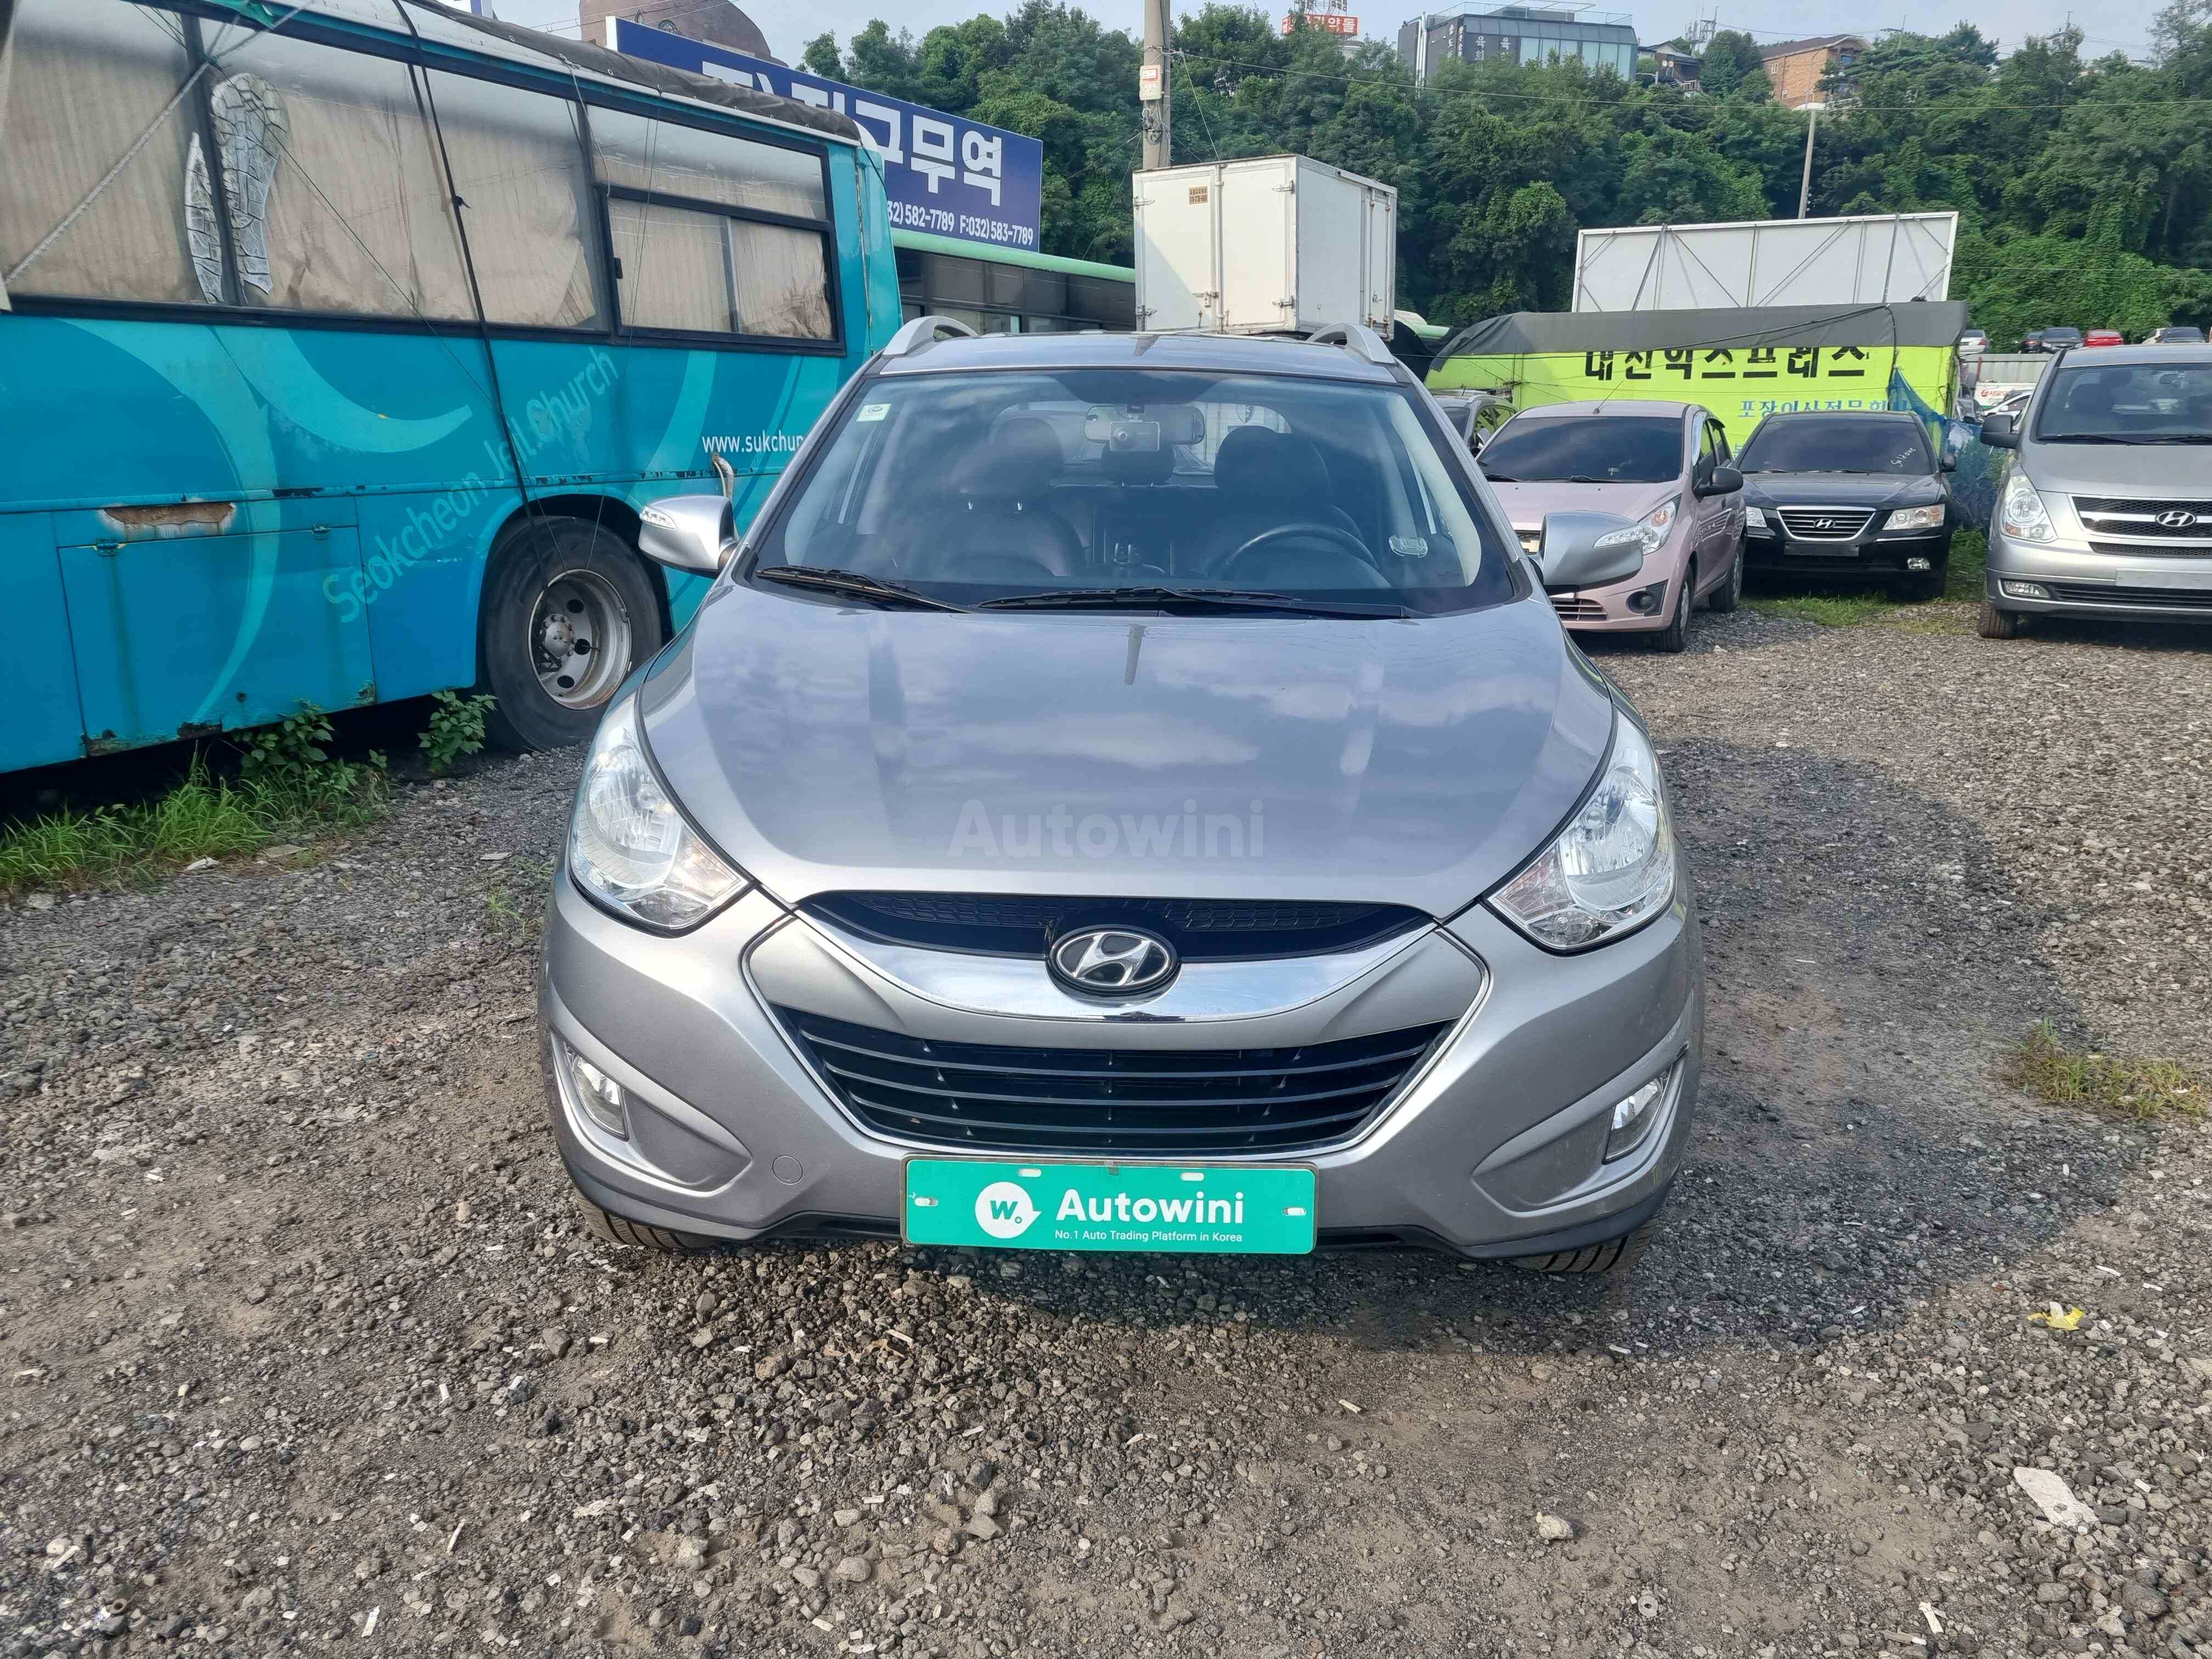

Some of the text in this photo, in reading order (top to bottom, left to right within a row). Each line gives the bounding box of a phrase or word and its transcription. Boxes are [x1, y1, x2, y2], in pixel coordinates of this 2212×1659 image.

[323, 472, 489, 623] Seokcheon
[1056, 1189, 1244, 1224] Autowini
[1082, 1230, 1107, 1240] Auto
[1109, 1230, 1149, 1243] Trading
[1152, 1231, 1197, 1241] Platform
[1200, 1232, 1209, 1241] in
[1212, 1232, 1243, 1242] Korea
